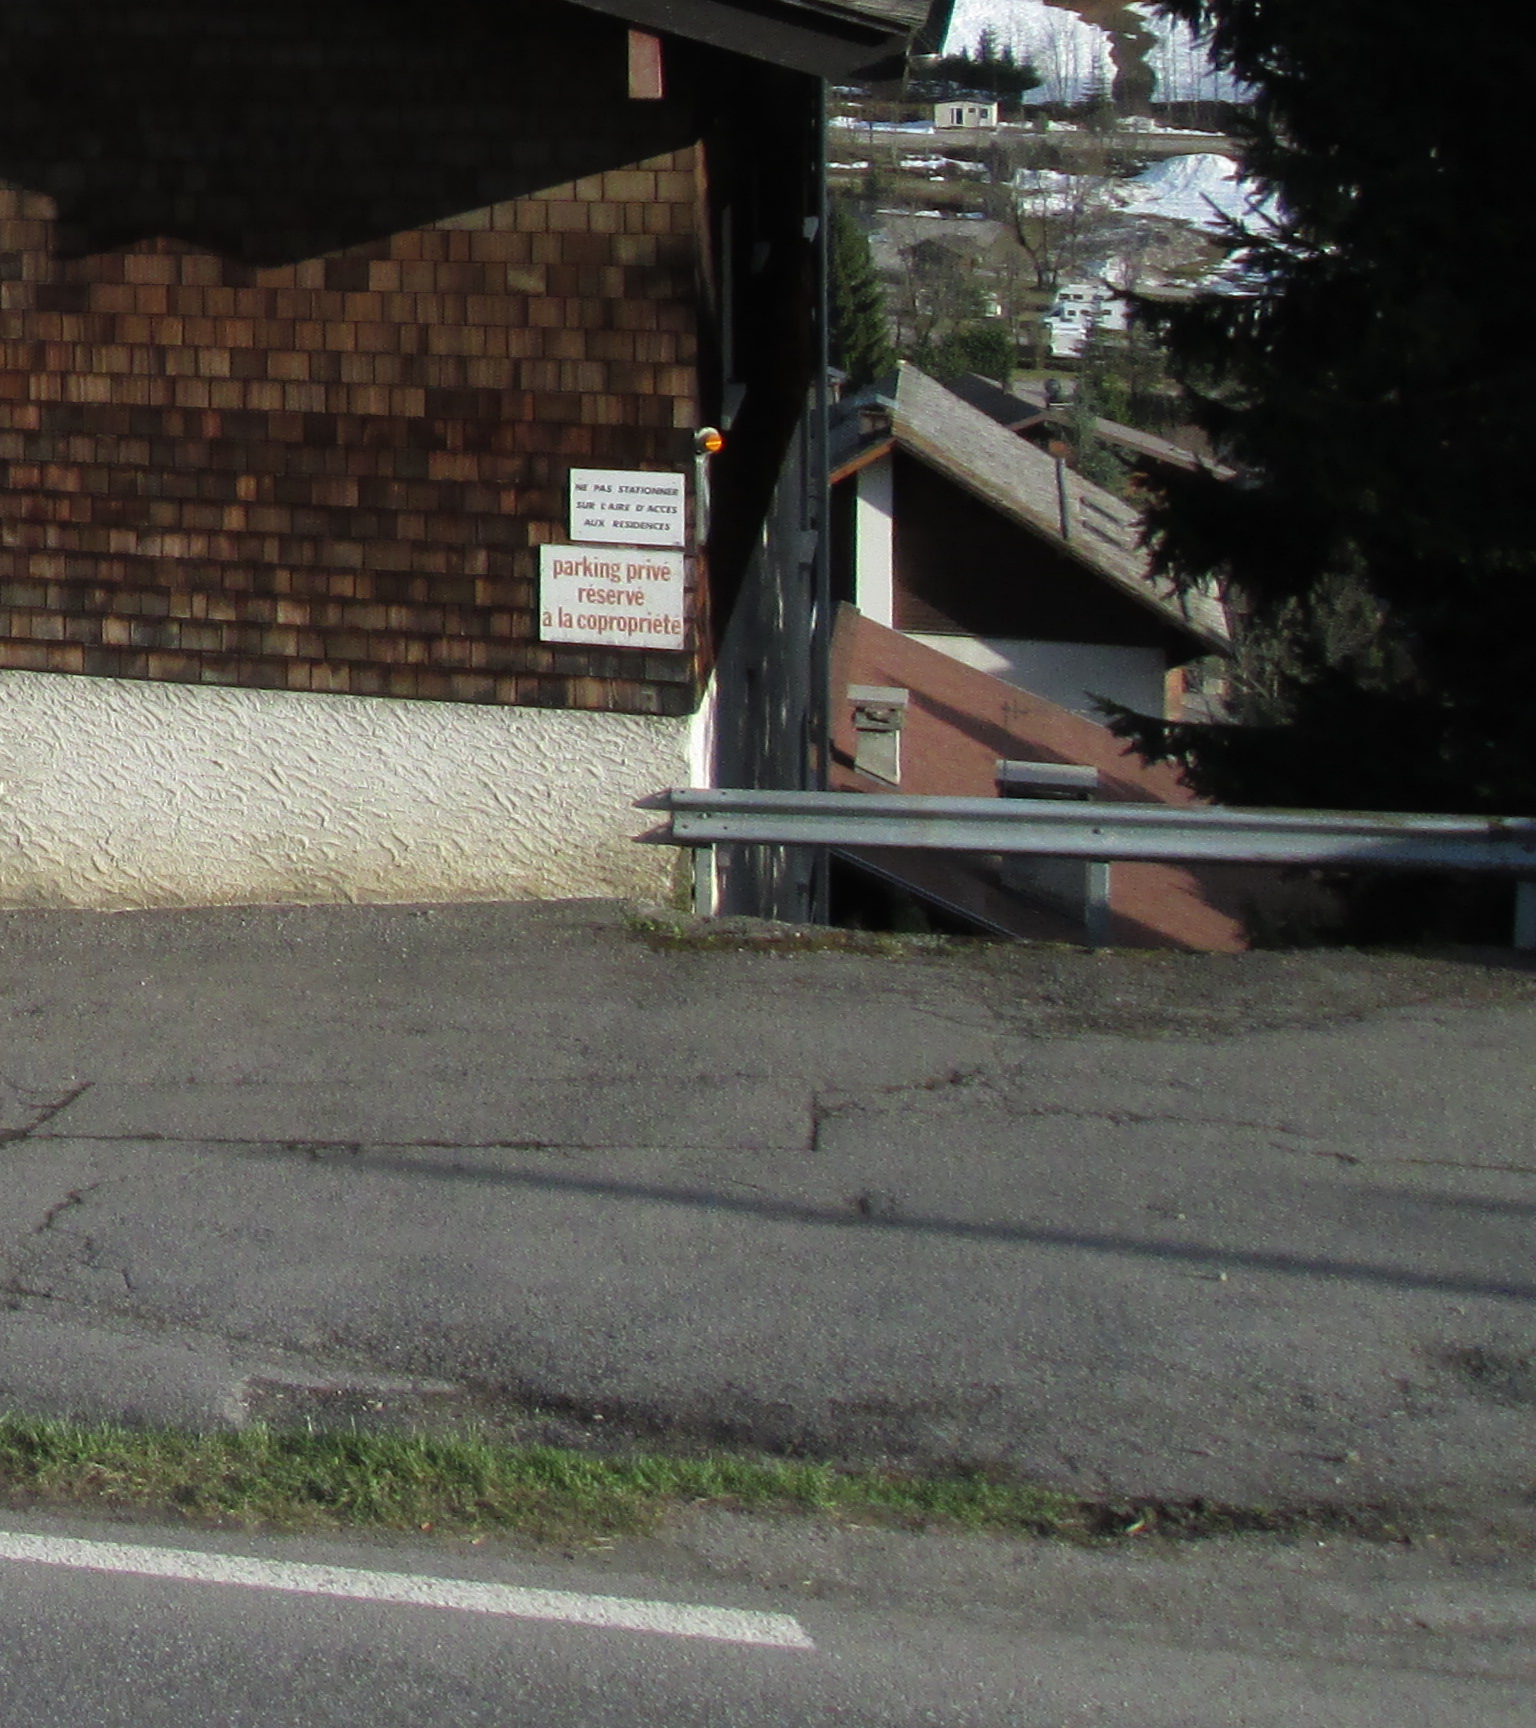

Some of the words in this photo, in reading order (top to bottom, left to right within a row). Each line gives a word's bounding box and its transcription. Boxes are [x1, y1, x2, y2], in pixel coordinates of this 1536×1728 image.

[575, 483, 588, 492] NE
[593, 484, 613, 493] PAS
[618, 485, 680, 496] STATIONNER
[576, 501, 596, 510] SUR
[583, 518, 606, 528] AUX
[553, 556, 621, 583] parking
[626, 558, 672, 583] privé
[577, 583, 645, 606] réservé
[558, 606, 573, 629] la
[577, 611, 682, 636] copropriété
